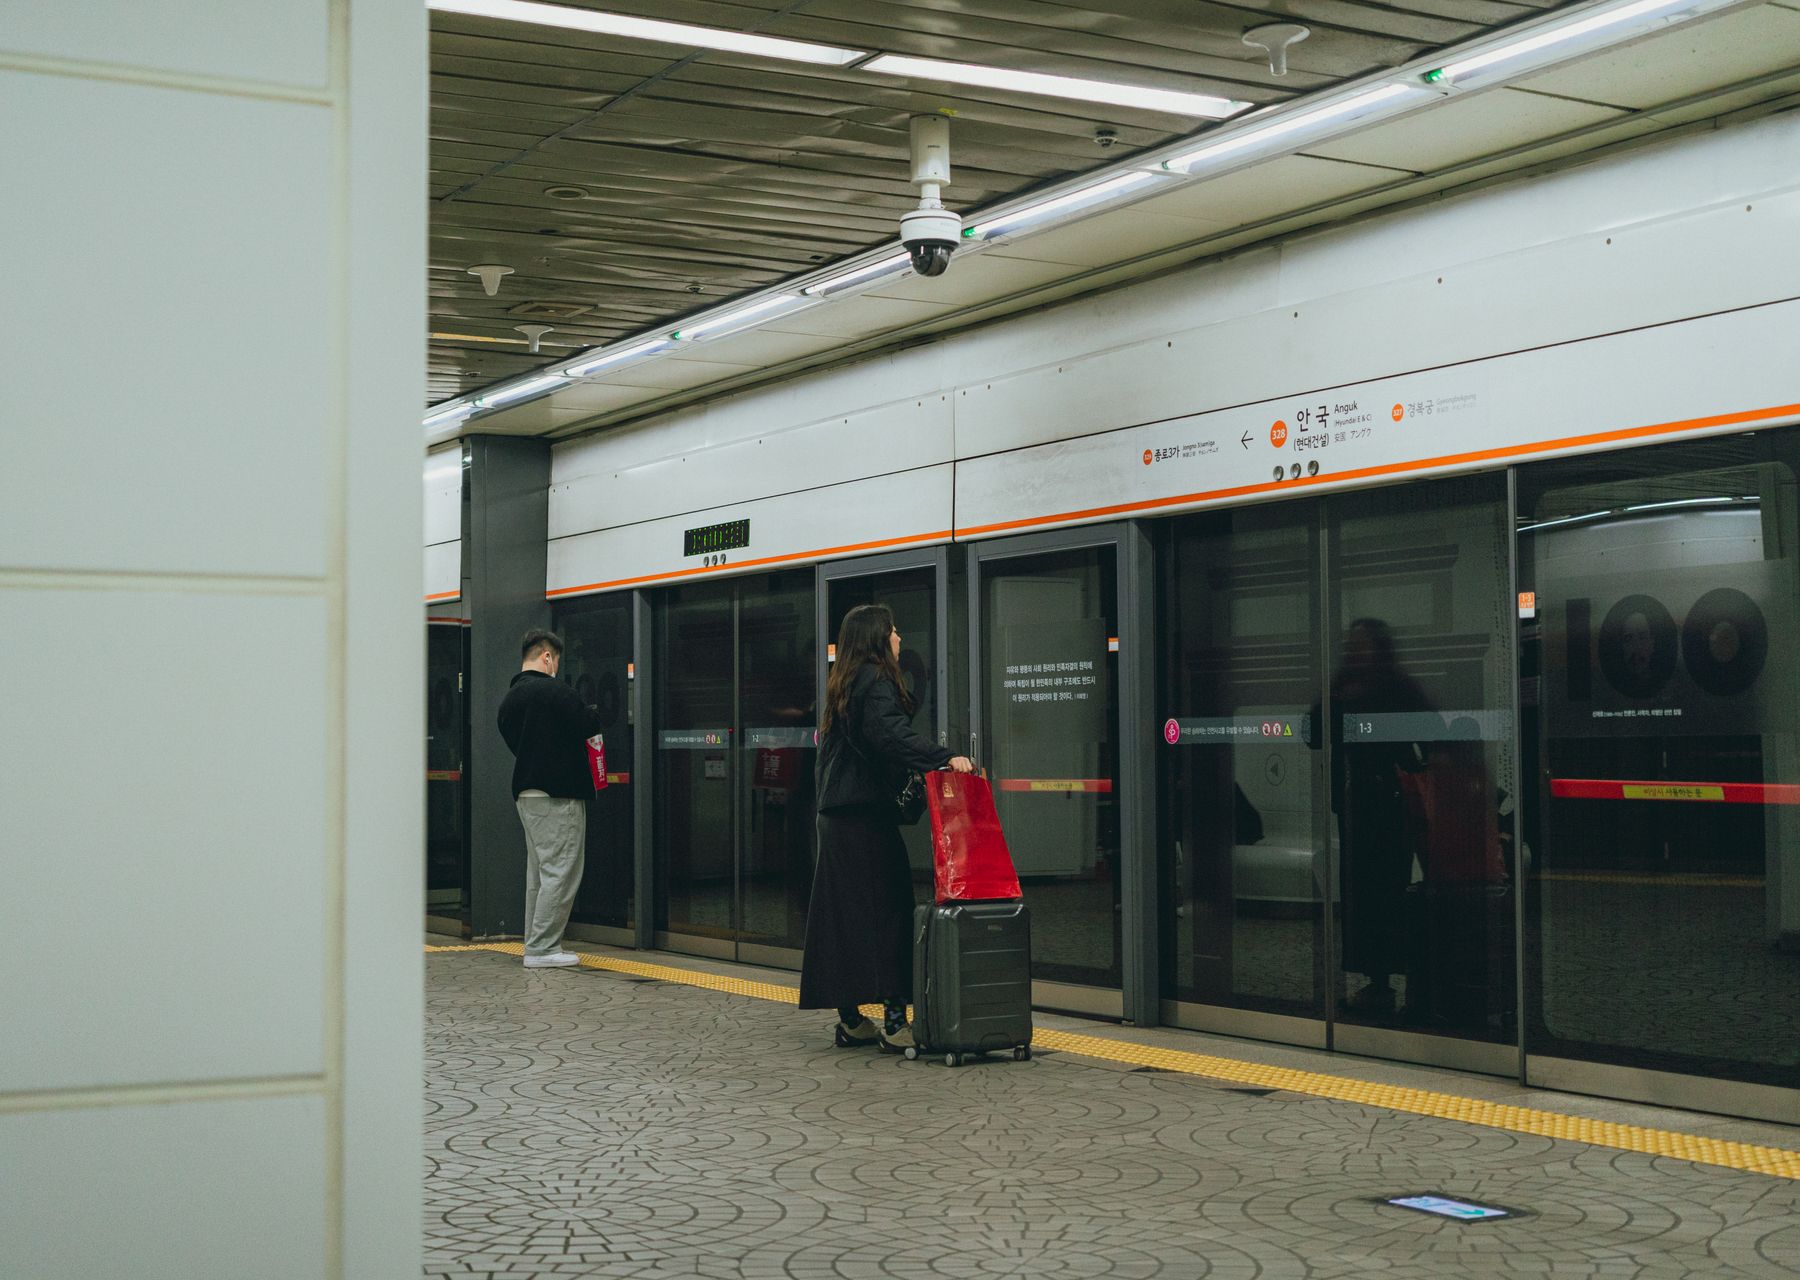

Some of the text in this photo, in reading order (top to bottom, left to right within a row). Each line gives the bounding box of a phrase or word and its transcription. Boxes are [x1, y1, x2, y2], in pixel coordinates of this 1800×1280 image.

[1334, 400, 1358, 415] Anguk
[1272, 429, 1286, 440] 328
[1293, 433, 1330, 452] (현대건설)
[1154, 444, 1180, 463] 종로3가
[1565, 587, 1769, 701] 100
[1082, 676, 1096, 685] 반드시
[1359, 722, 1372, 734] 1-3
